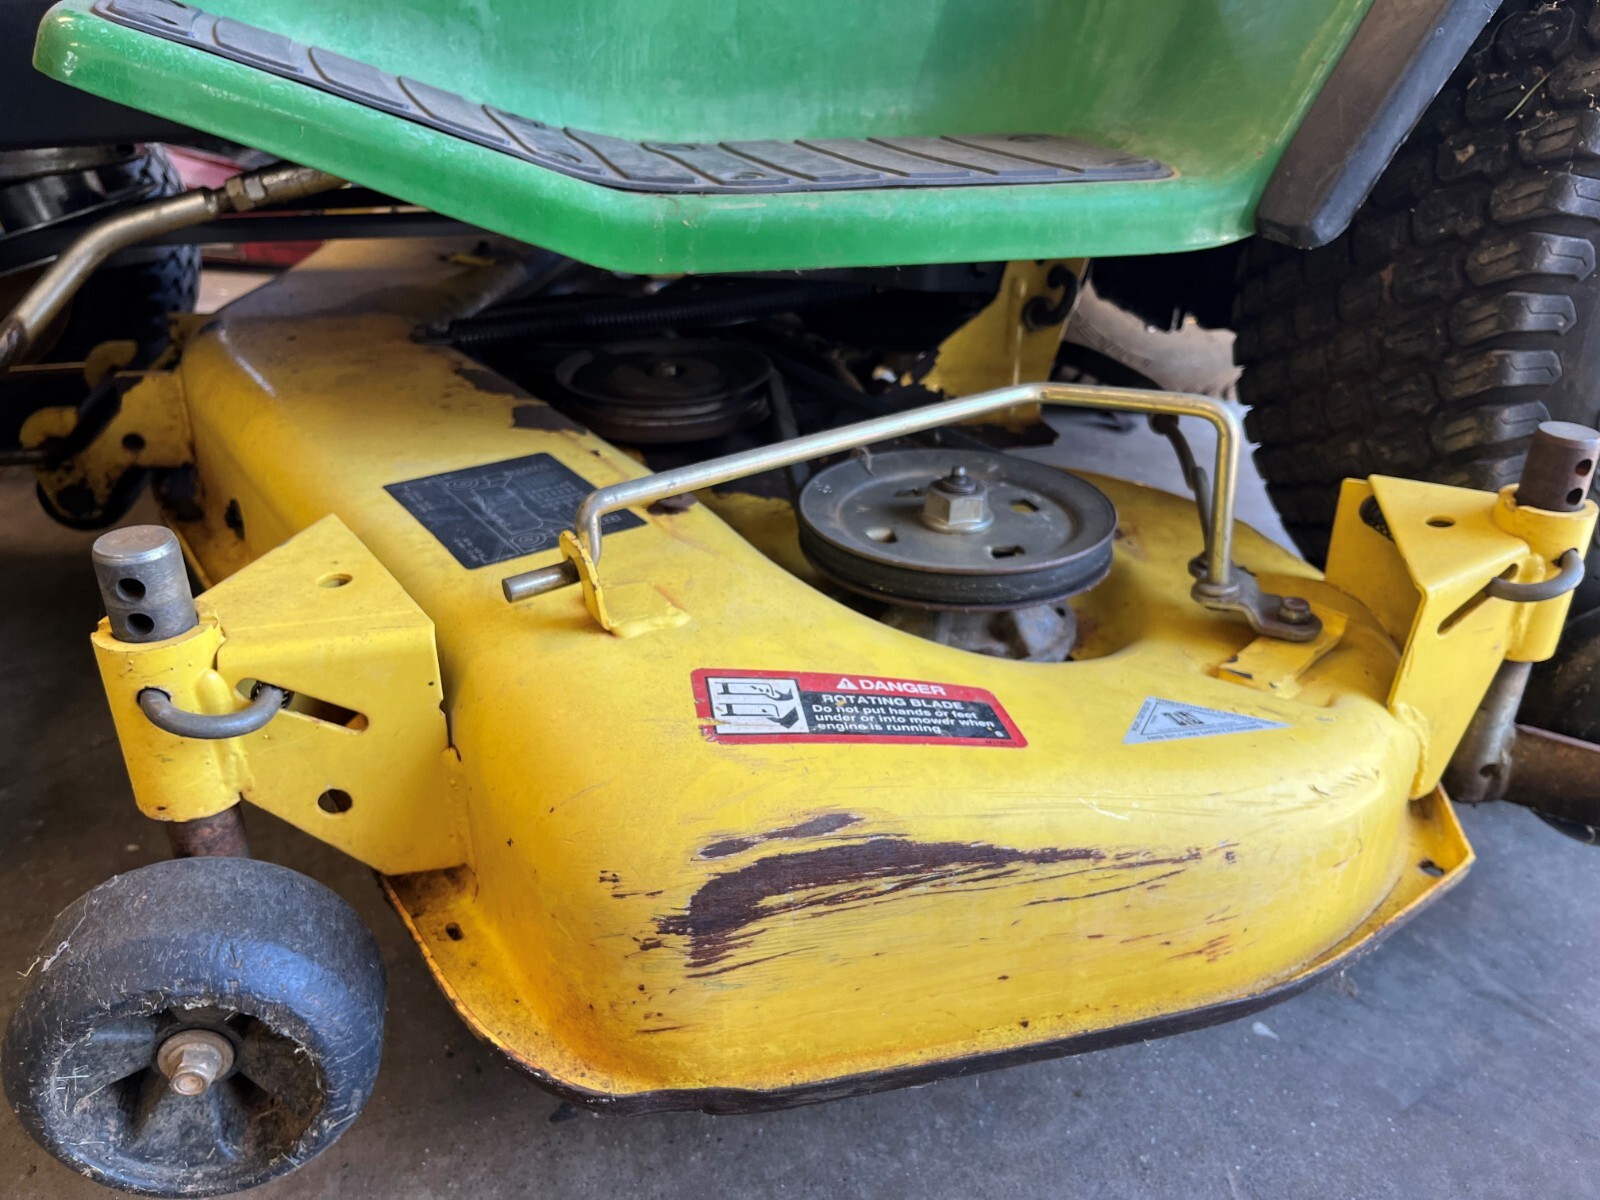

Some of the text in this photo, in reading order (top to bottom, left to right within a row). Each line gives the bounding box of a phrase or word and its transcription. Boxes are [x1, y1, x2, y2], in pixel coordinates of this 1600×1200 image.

[859, 679, 946, 696] DANGER
[822, 694, 964, 710] ROTATING BLADE
[812, 704, 978, 719] Do not put hands or feet
[815, 713, 856, 722] under
[879, 715, 906, 723] into
[909, 717, 955, 726] mower
[959, 719, 995, 728] when
[817, 722, 942, 735] engine is running
